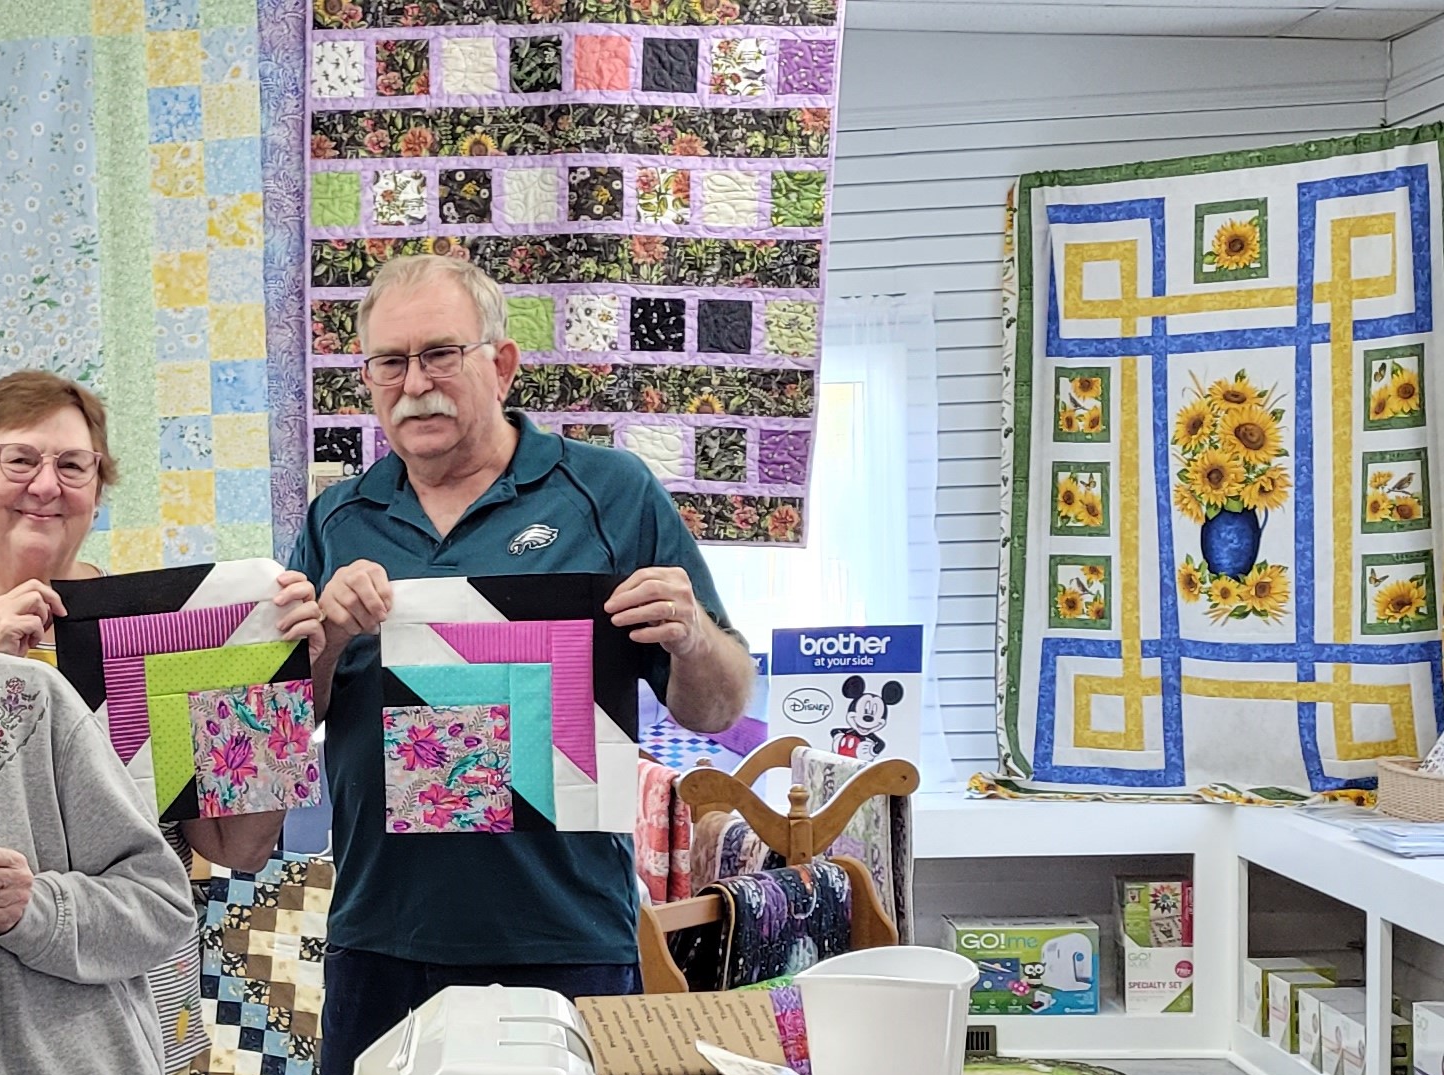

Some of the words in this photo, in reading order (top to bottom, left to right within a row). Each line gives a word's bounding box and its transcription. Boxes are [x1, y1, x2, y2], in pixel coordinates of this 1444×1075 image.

[799, 633, 892, 656] brother
[814, 657, 825, 666] at
[827, 657, 850, 669] your
[851, 655, 874, 666] side
[1127, 981, 1167, 990] SPECIALTY
[1168, 981, 1183, 989] SET
